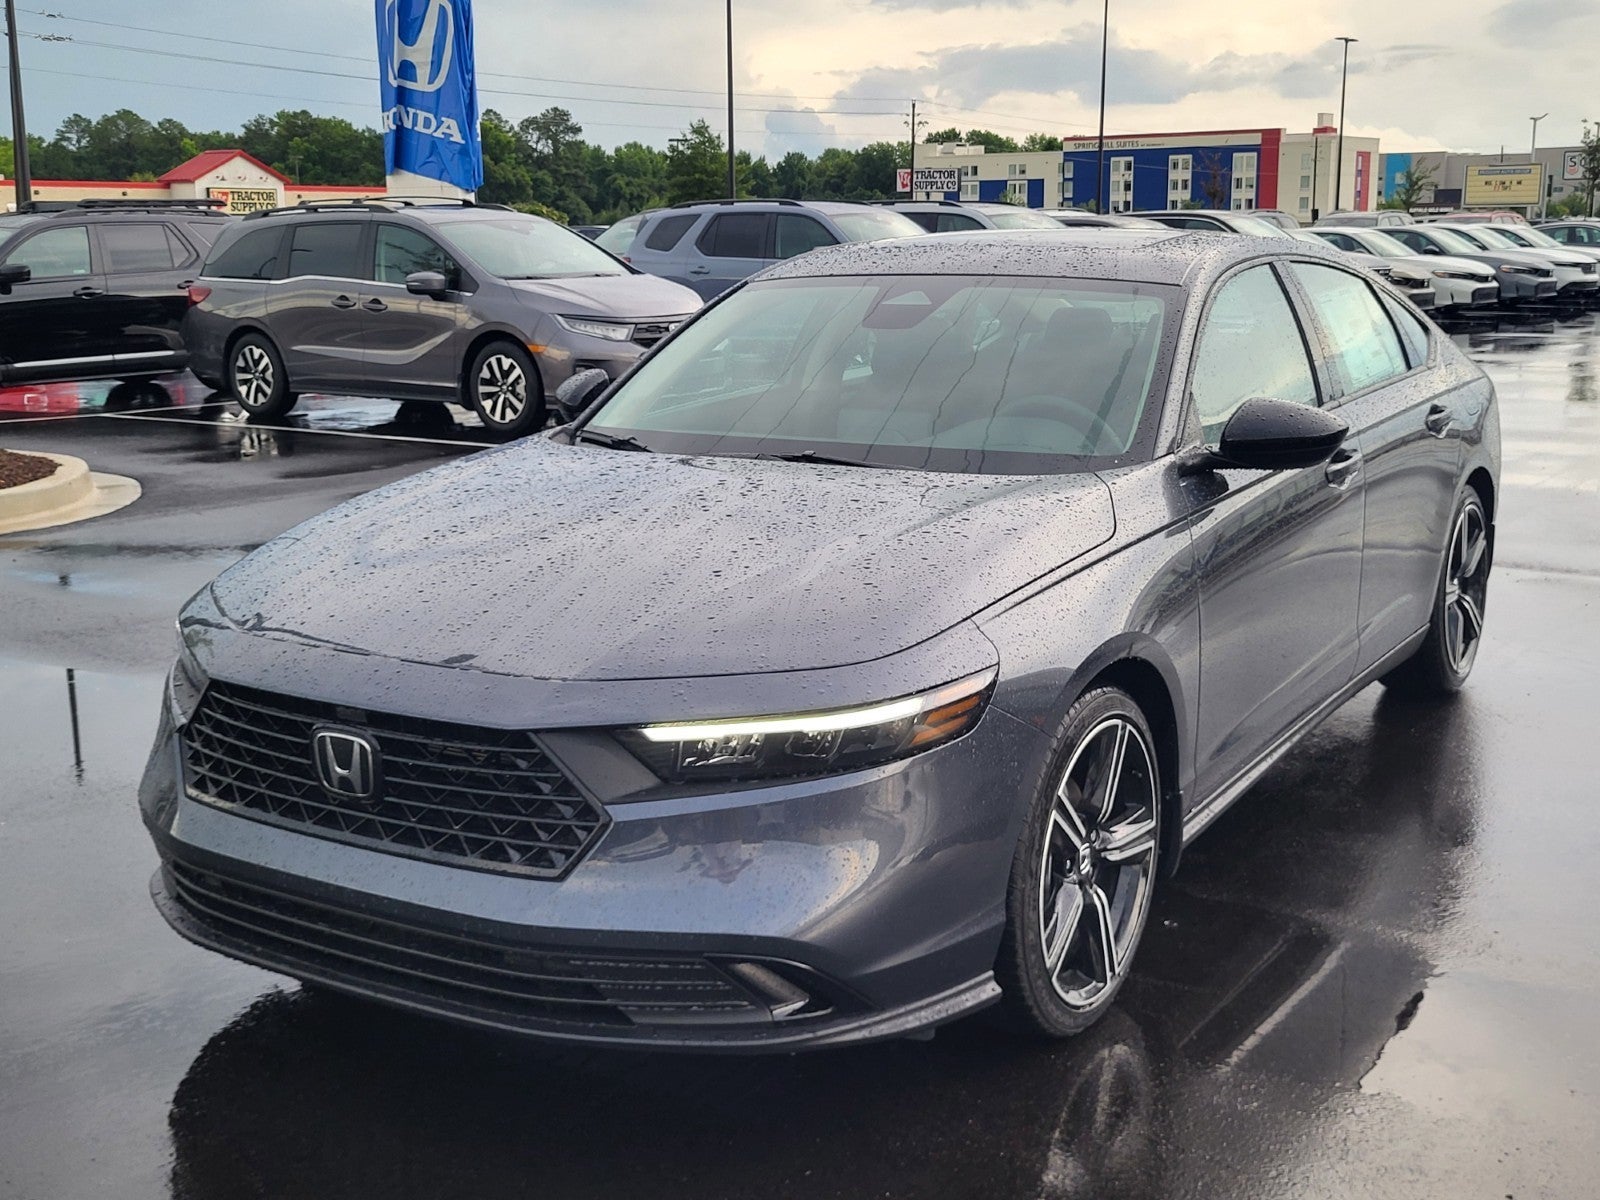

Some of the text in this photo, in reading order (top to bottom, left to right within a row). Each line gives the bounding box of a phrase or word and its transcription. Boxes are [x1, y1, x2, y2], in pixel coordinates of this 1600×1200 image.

[1116, 140, 1139, 148] SUITES
[914, 170, 956, 180] TRACTOR
[913, 180, 946, 190] SUPPLY
[230, 191, 275, 201] TRACTOR
[230, 202, 264, 212] SUPPLY
